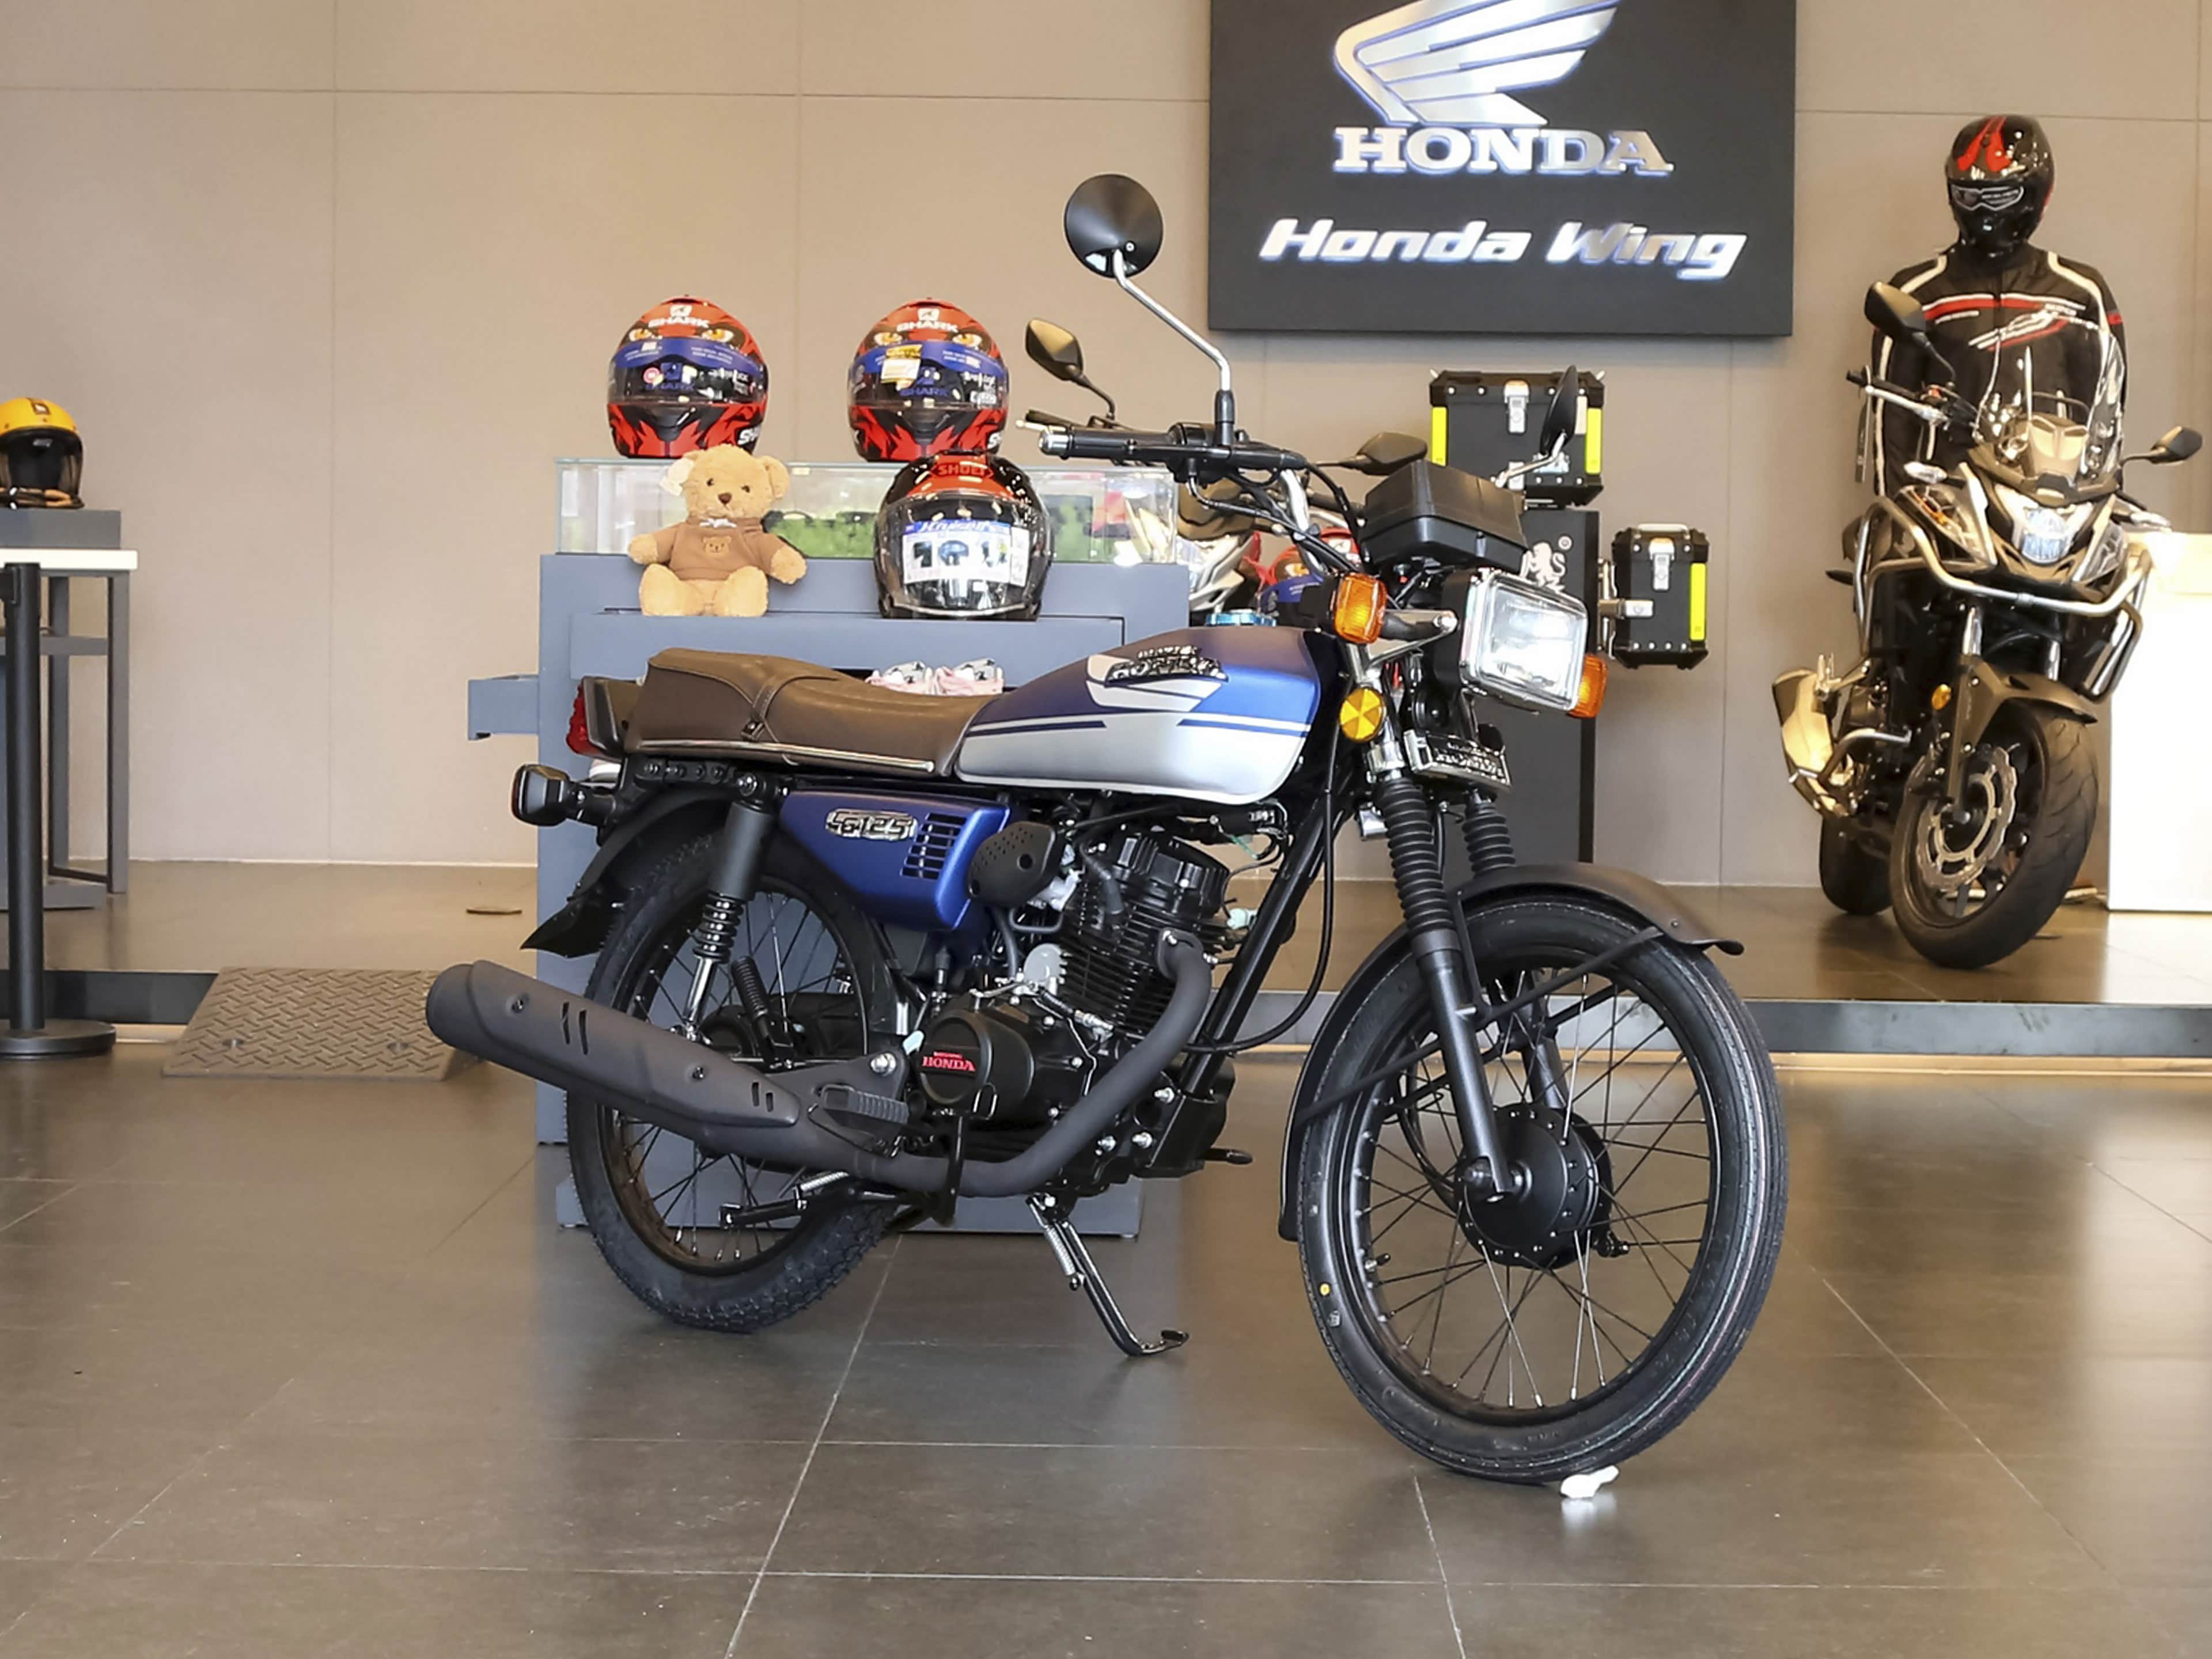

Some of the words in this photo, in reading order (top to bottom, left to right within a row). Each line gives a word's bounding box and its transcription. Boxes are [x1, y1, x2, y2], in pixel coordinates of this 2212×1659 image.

[1332, 126, 1675, 175] HONDA
[1259, 218, 1532, 263] Honda
[1546, 222, 1748, 279] Wing
[922, 1056, 976, 1071] HONDA
